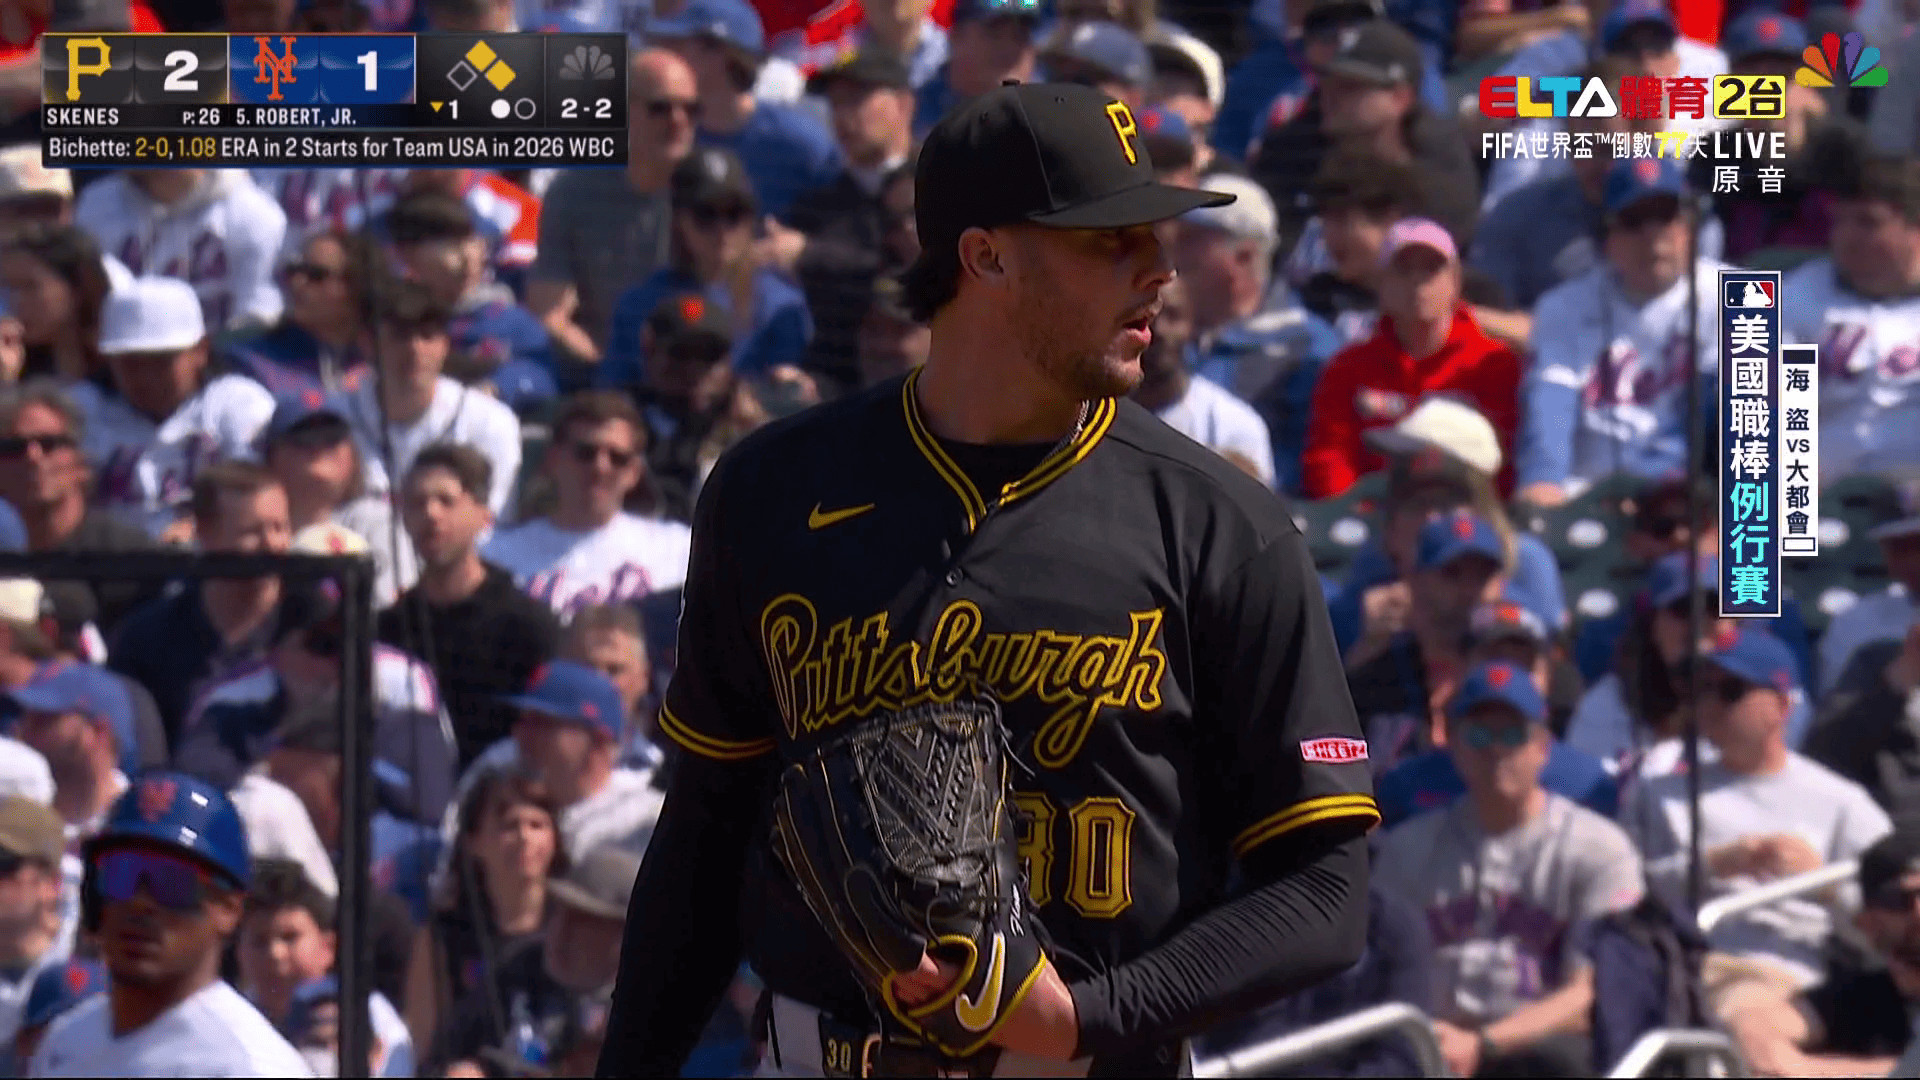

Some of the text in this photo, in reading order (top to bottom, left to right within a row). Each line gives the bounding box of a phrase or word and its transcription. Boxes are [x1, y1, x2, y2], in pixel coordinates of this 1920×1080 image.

[1104, 100, 1138, 166] P
[761, 593, 1166, 768] Pittsburgh
[827, 1038, 852, 1072] 30
